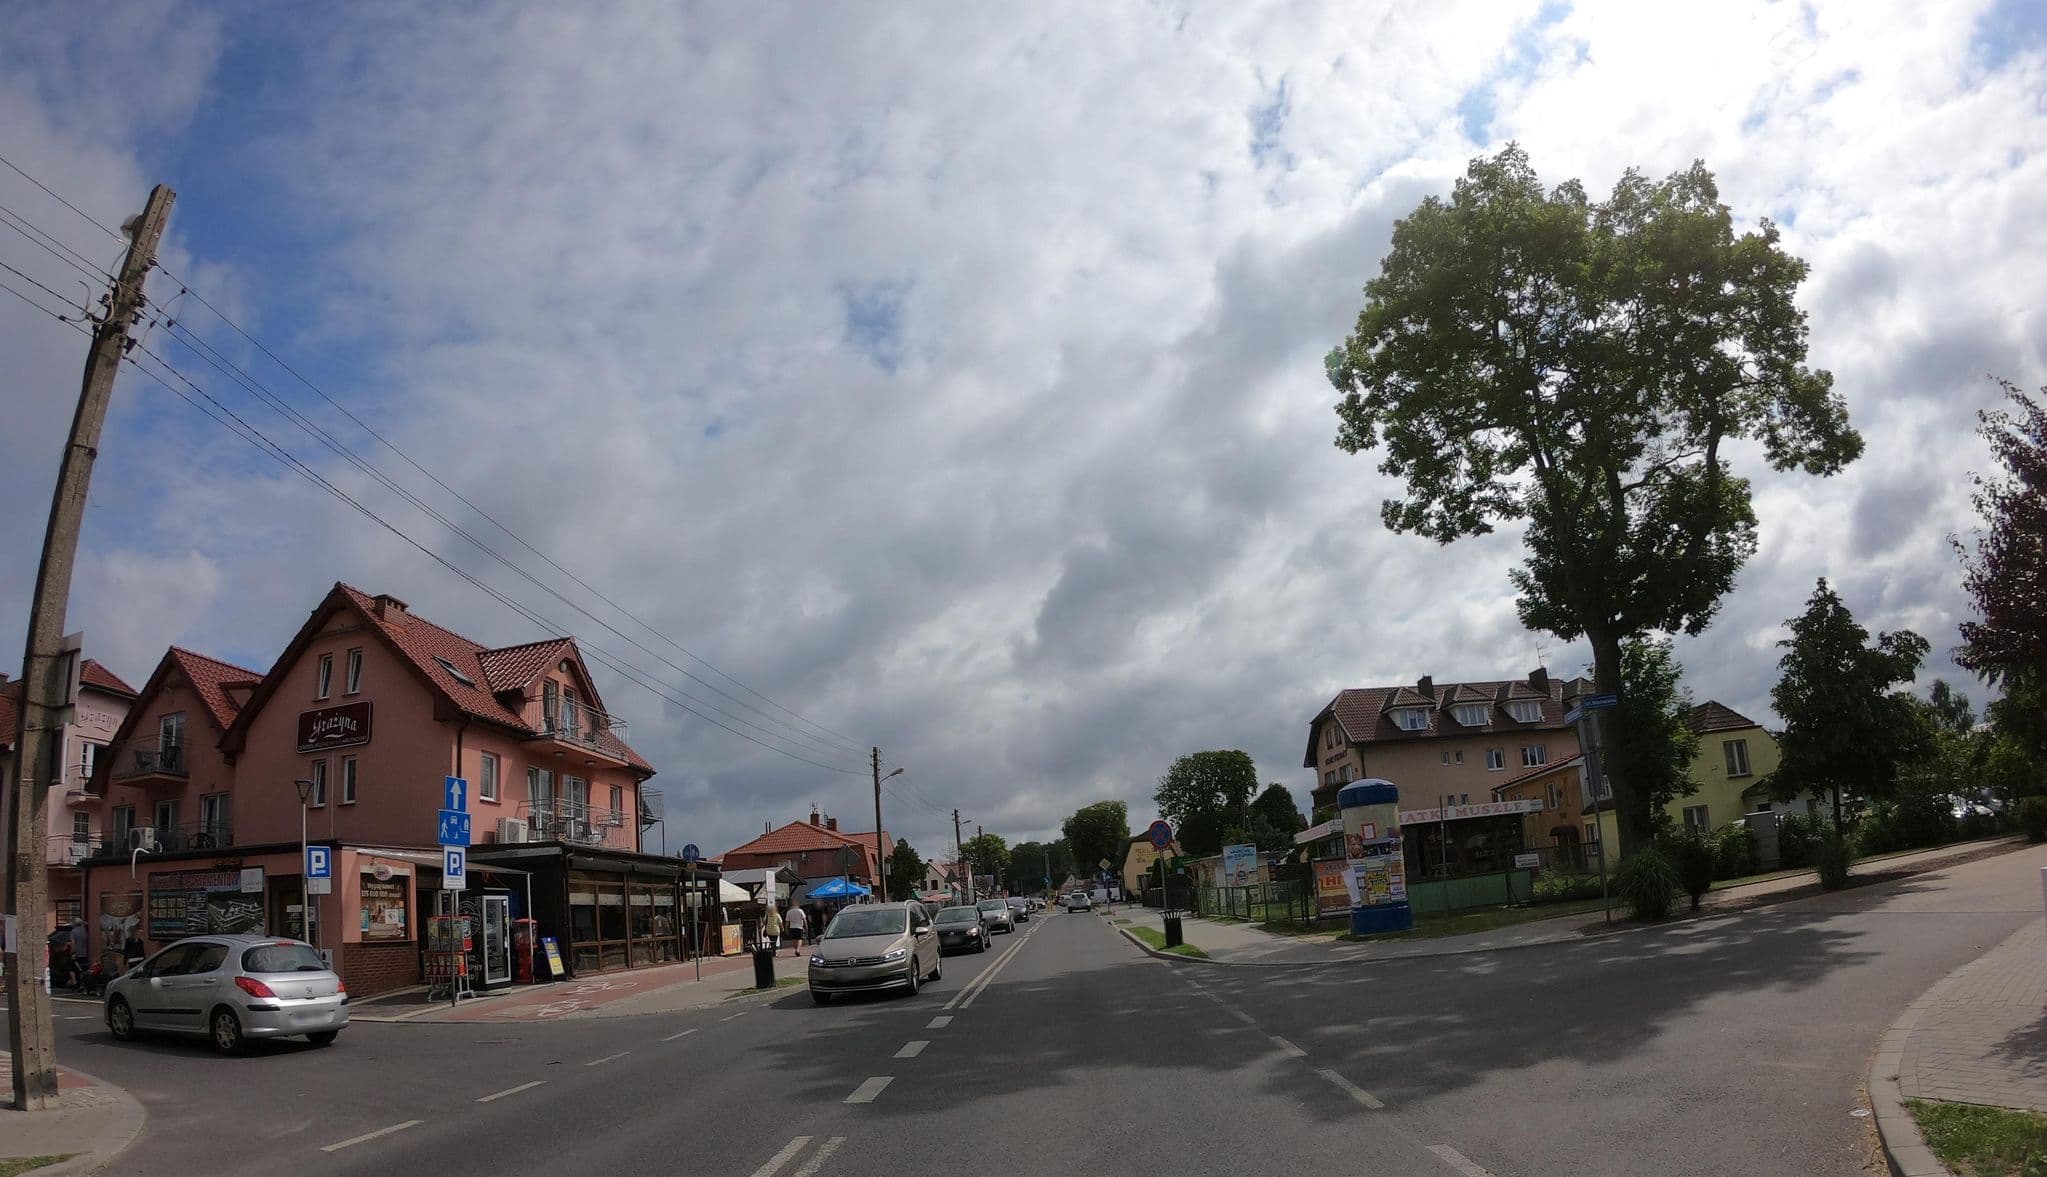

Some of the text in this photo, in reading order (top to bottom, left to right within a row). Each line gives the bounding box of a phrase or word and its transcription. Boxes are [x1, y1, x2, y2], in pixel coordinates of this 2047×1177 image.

[308, 711, 357, 743] Grażyna
[1455, 801, 1525, 818] MUSZLE
[311, 851, 326, 875] P
[450, 852, 461, 874] P
